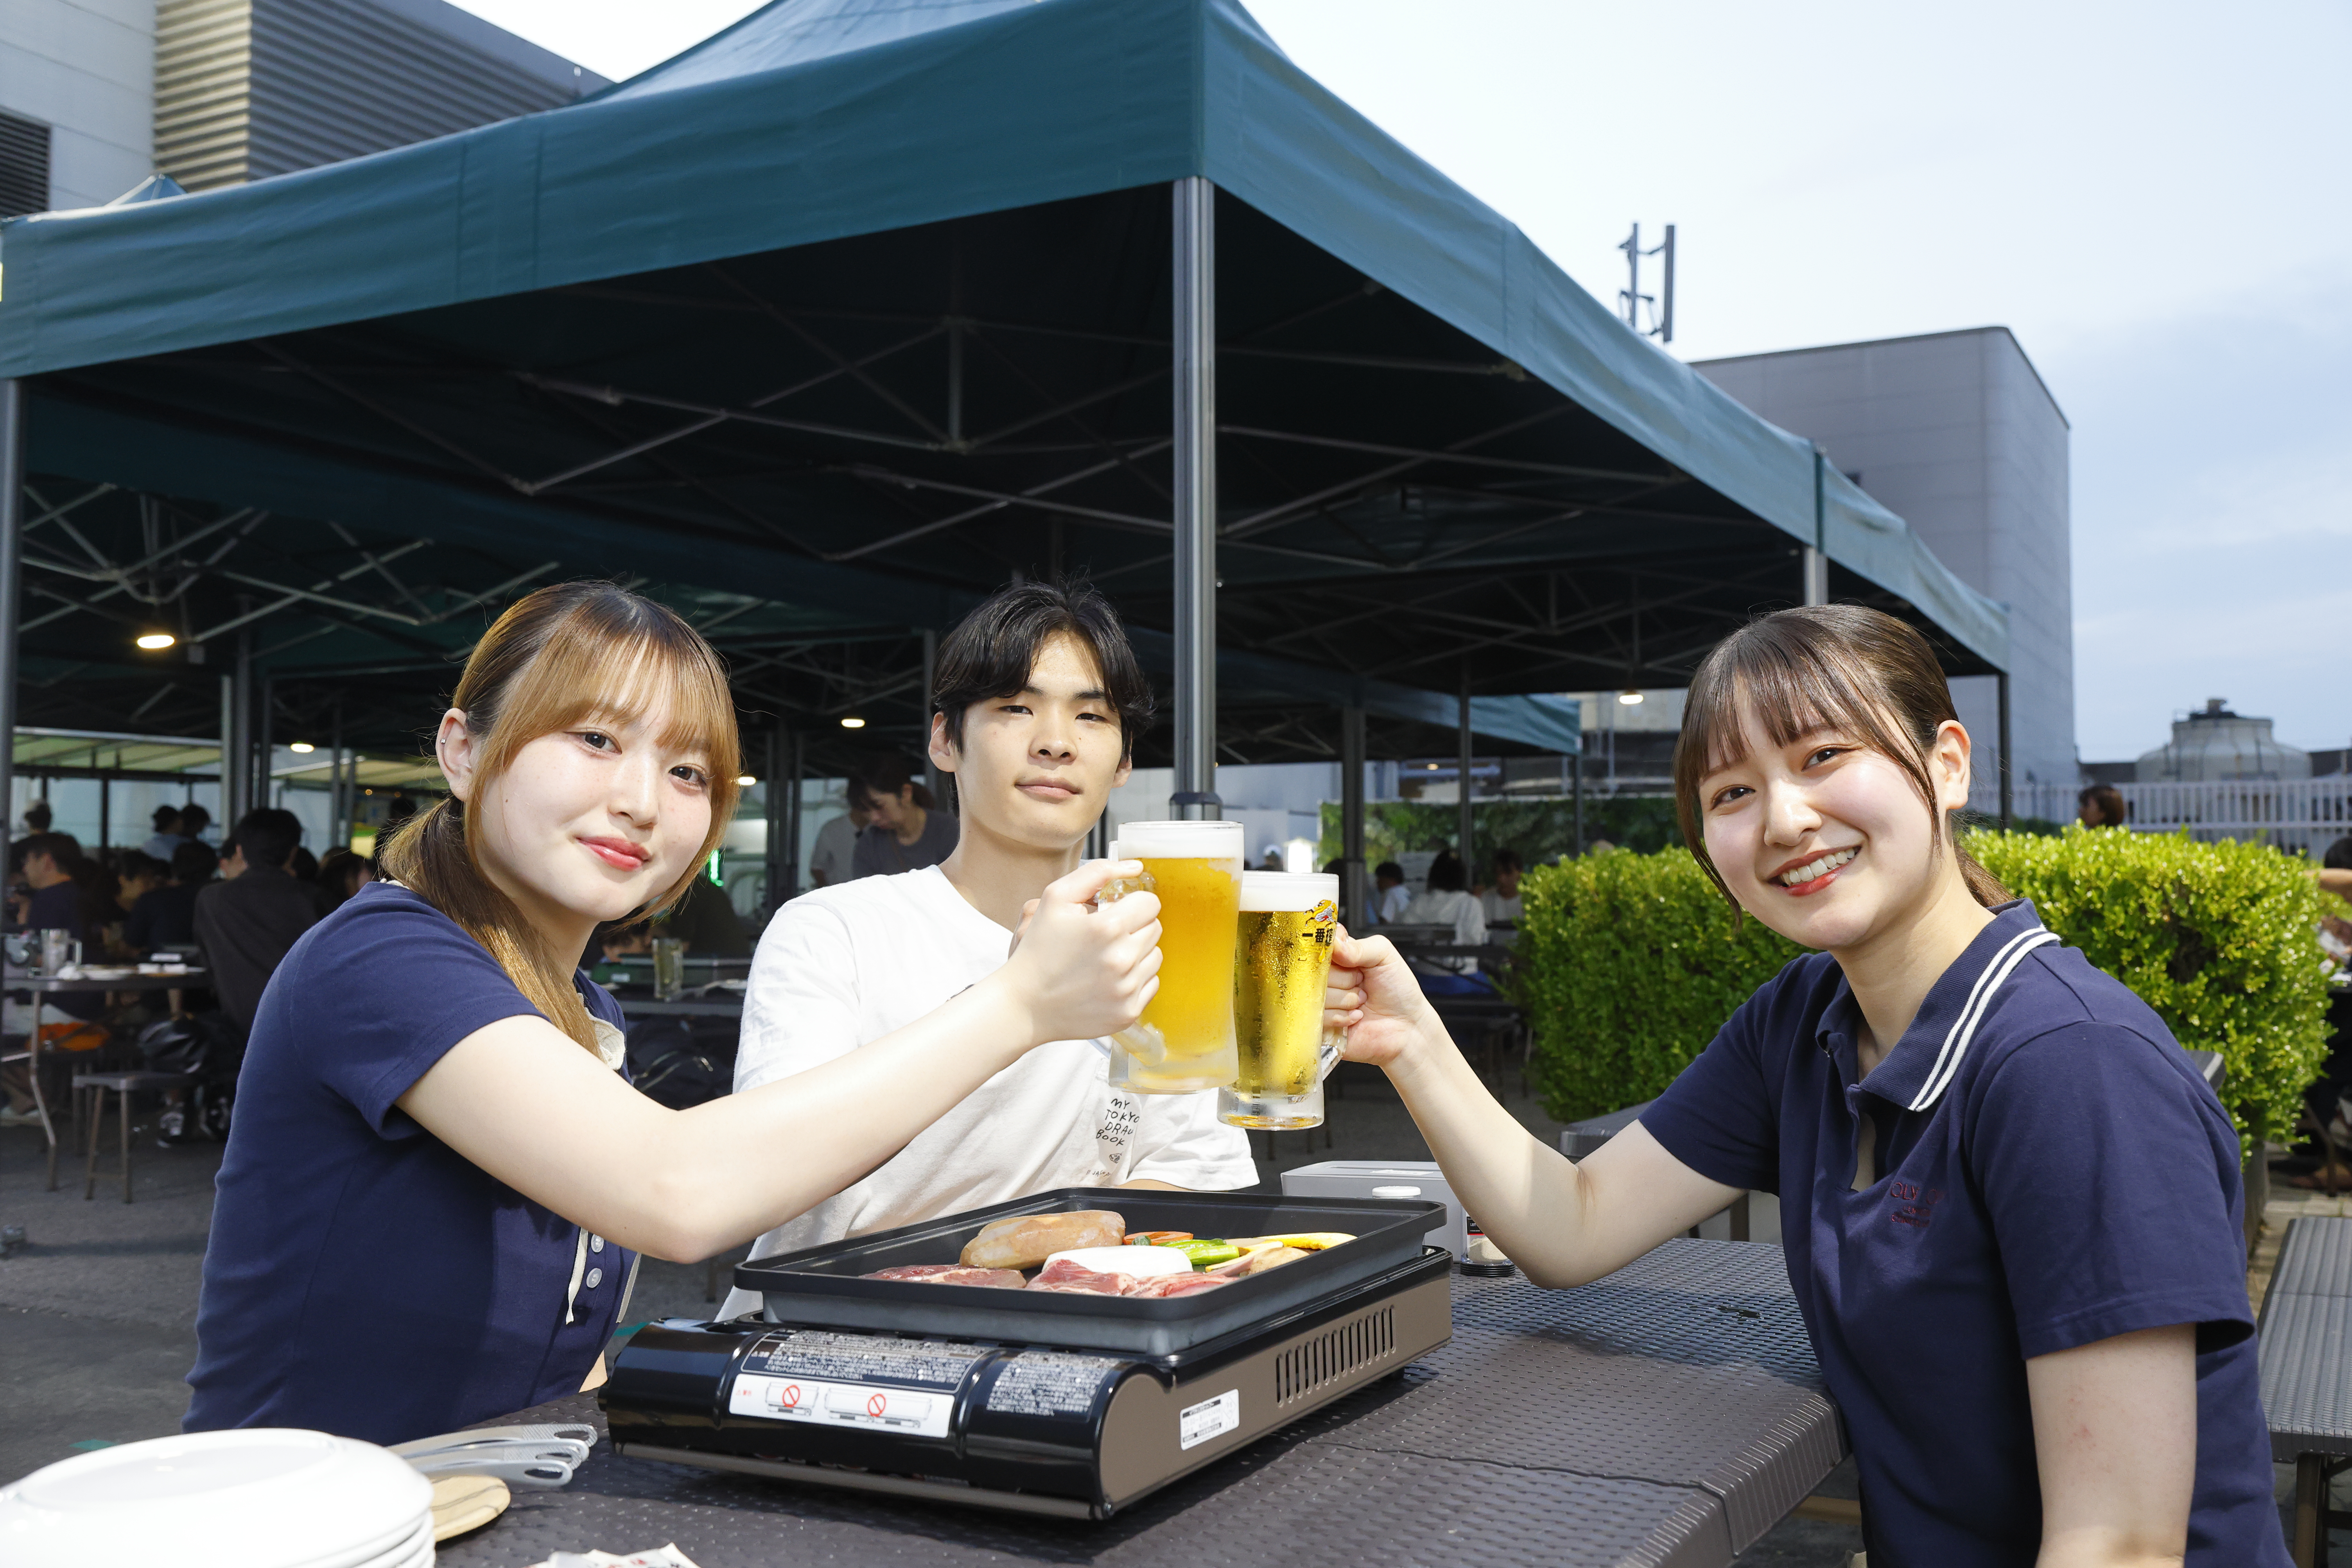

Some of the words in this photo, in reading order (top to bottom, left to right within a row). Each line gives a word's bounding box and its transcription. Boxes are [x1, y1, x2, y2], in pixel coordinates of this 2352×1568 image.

[1302, 928, 1335, 946] 一番搾
[1111, 1098, 1130, 1110] MY
[1105, 1109, 1140, 1123] TOKYO
[1096, 1129, 1125, 1146] BOOK
